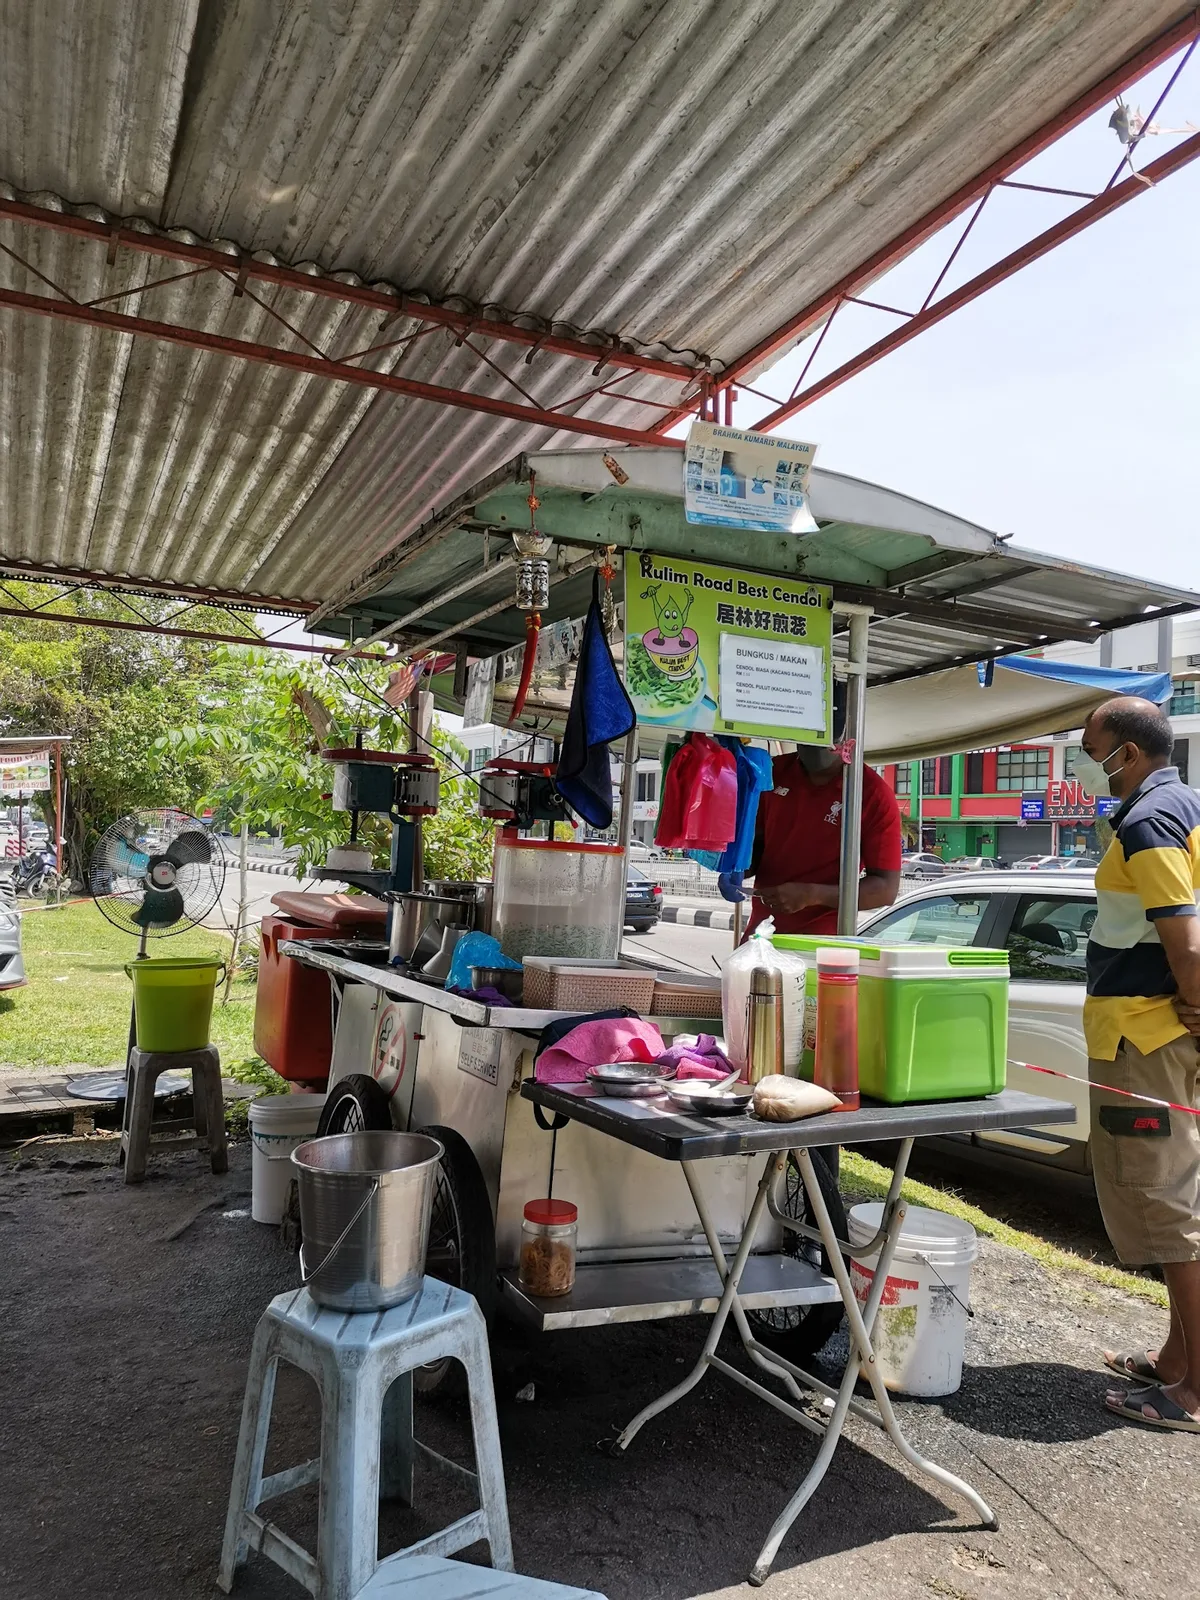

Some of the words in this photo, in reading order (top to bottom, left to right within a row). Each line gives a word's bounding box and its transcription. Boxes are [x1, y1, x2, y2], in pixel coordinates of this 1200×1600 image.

[713, 428, 743, 441] BRAHMA
[743, 434, 775, 447] KUMARIS
[776, 440, 810, 453] MALAYSIA
[641, 563, 689, 585] Kulim
[693, 572, 733, 593] Road
[737, 580, 769, 599] Best
[772, 587, 822, 608] Cendol
[659, 657, 677, 666] KULIM
[677, 654, 690, 665] BEST
[736, 648, 775, 661] BUNGKUS
[779, 654, 808, 665] MAKAN
[668, 664, 686, 672] CENDOL
[736, 664, 755, 672] CENDOL
[755, 666, 770, 674] BIASA
[770, 668, 791, 677] (KACANG
[755, 684, 771, 692] PULUT
[771, 686, 792, 694] (KACANG
[1047, 779, 1096, 807] ENG
[461, 1052, 474, 1068] SELF
[474, 1057, 497, 1079] SERVICE
